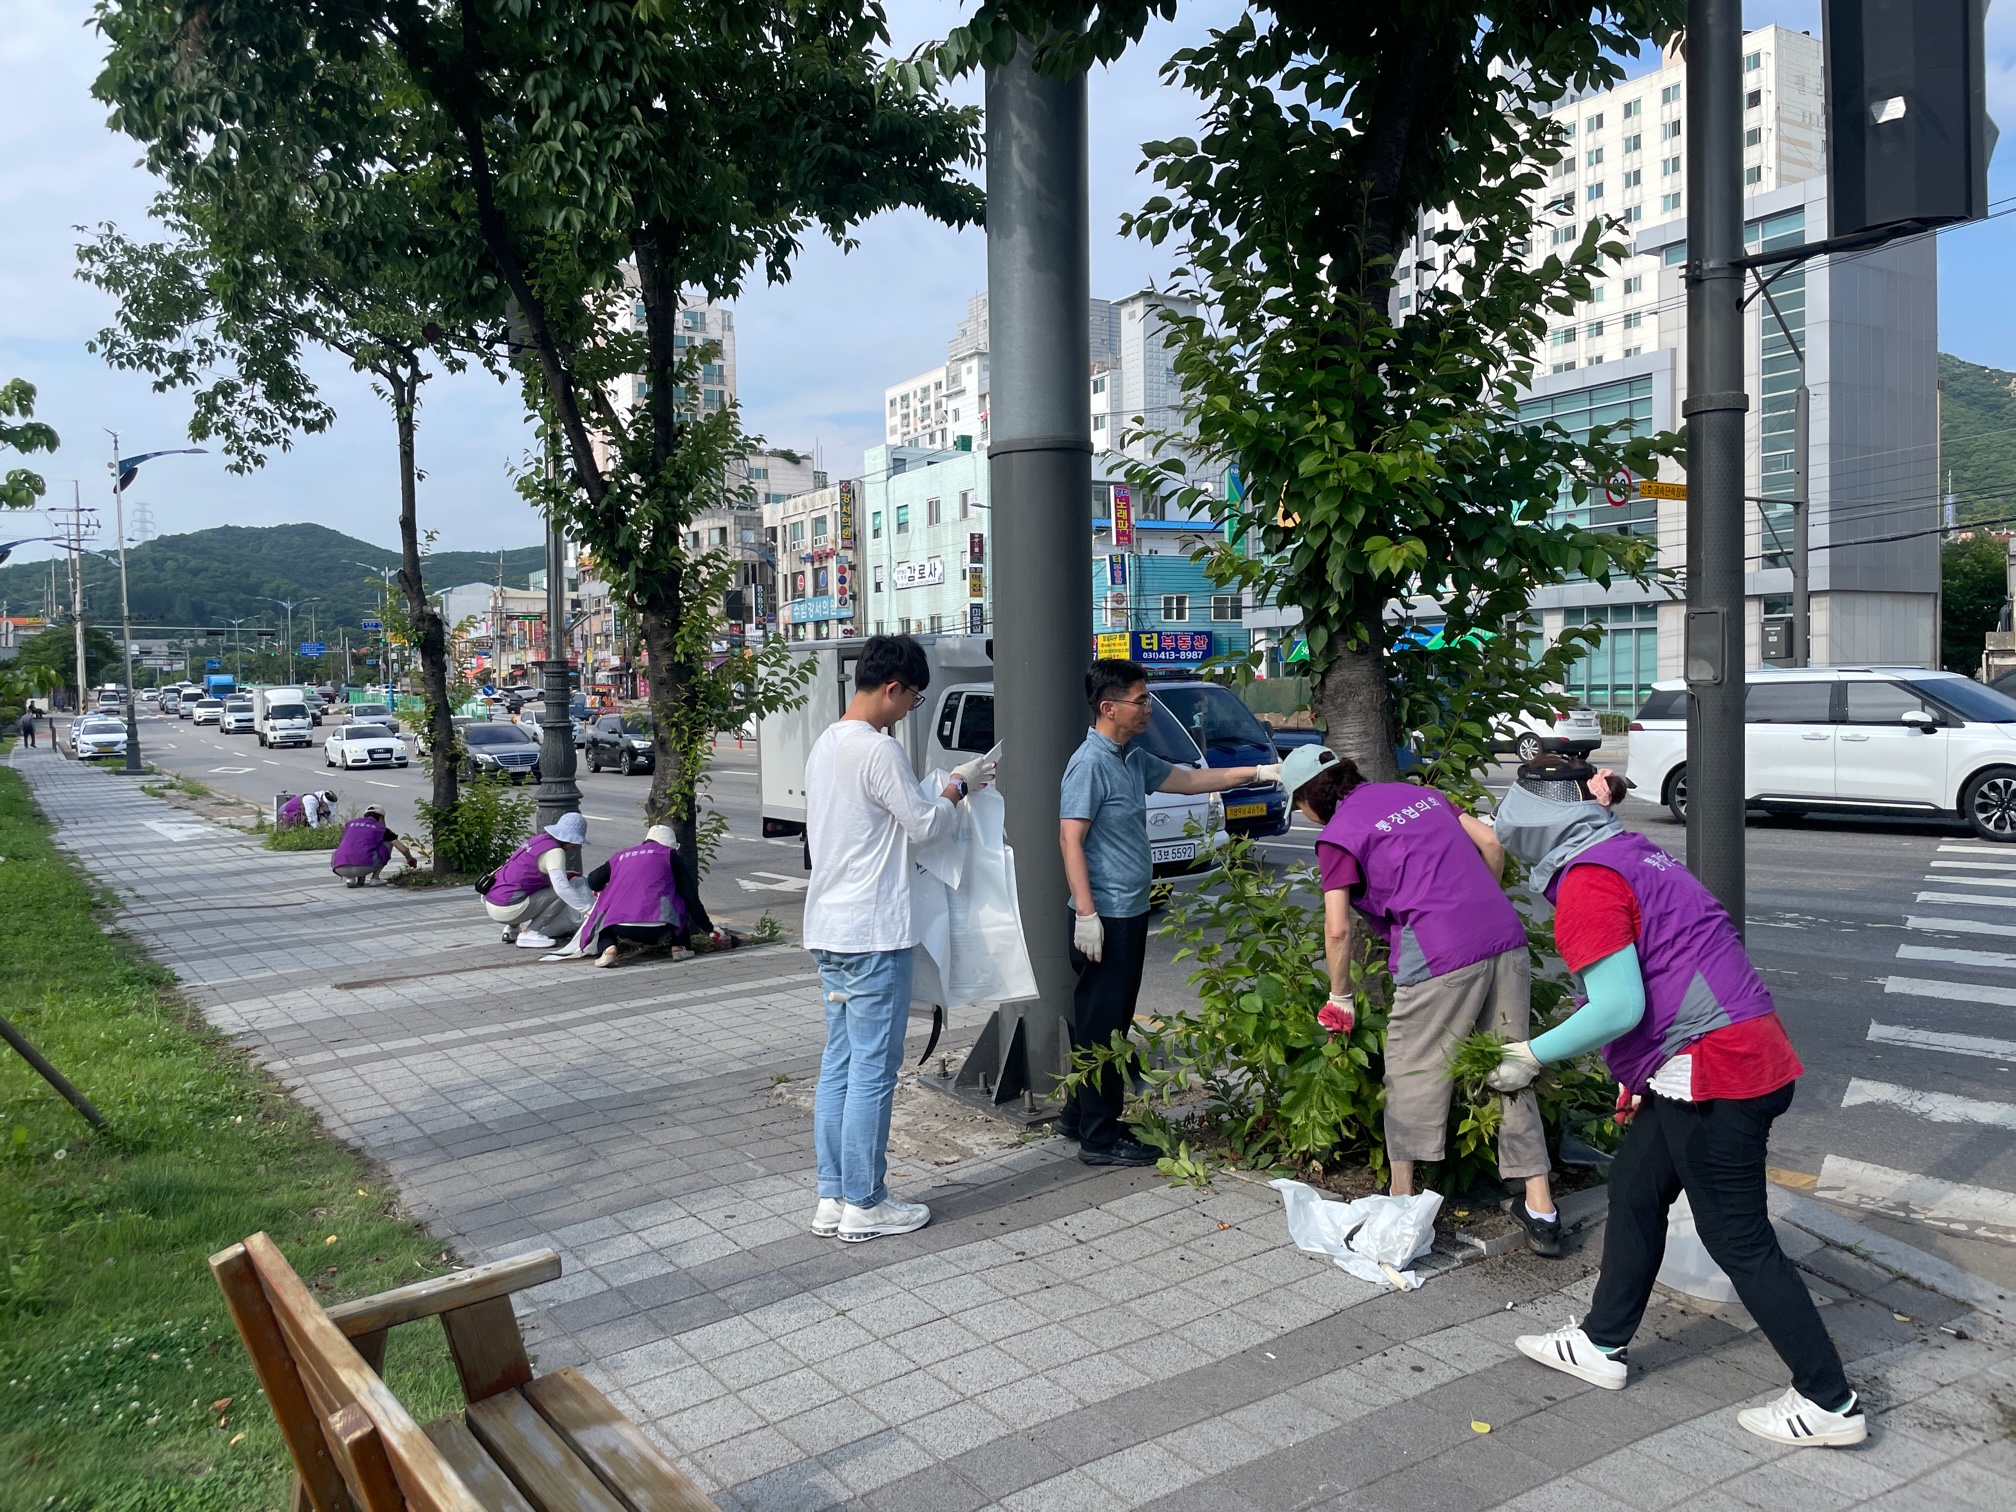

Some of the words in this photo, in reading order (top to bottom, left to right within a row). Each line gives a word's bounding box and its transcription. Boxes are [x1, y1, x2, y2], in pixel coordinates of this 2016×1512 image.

[841, 493, 852, 539] 강서의원
[1111, 554, 1122, 564] 터
[907, 561, 937, 582] 감로사
[793, 599, 837, 619] 수암강서의원
[1139, 633, 1158, 651] 터
[1161, 635, 1209, 651] 부동산
[1143, 651, 1203, 659] 031)413-8987
[1247, 805, 1265, 815] 4616
[1171, 845, 1194, 860] 5592
